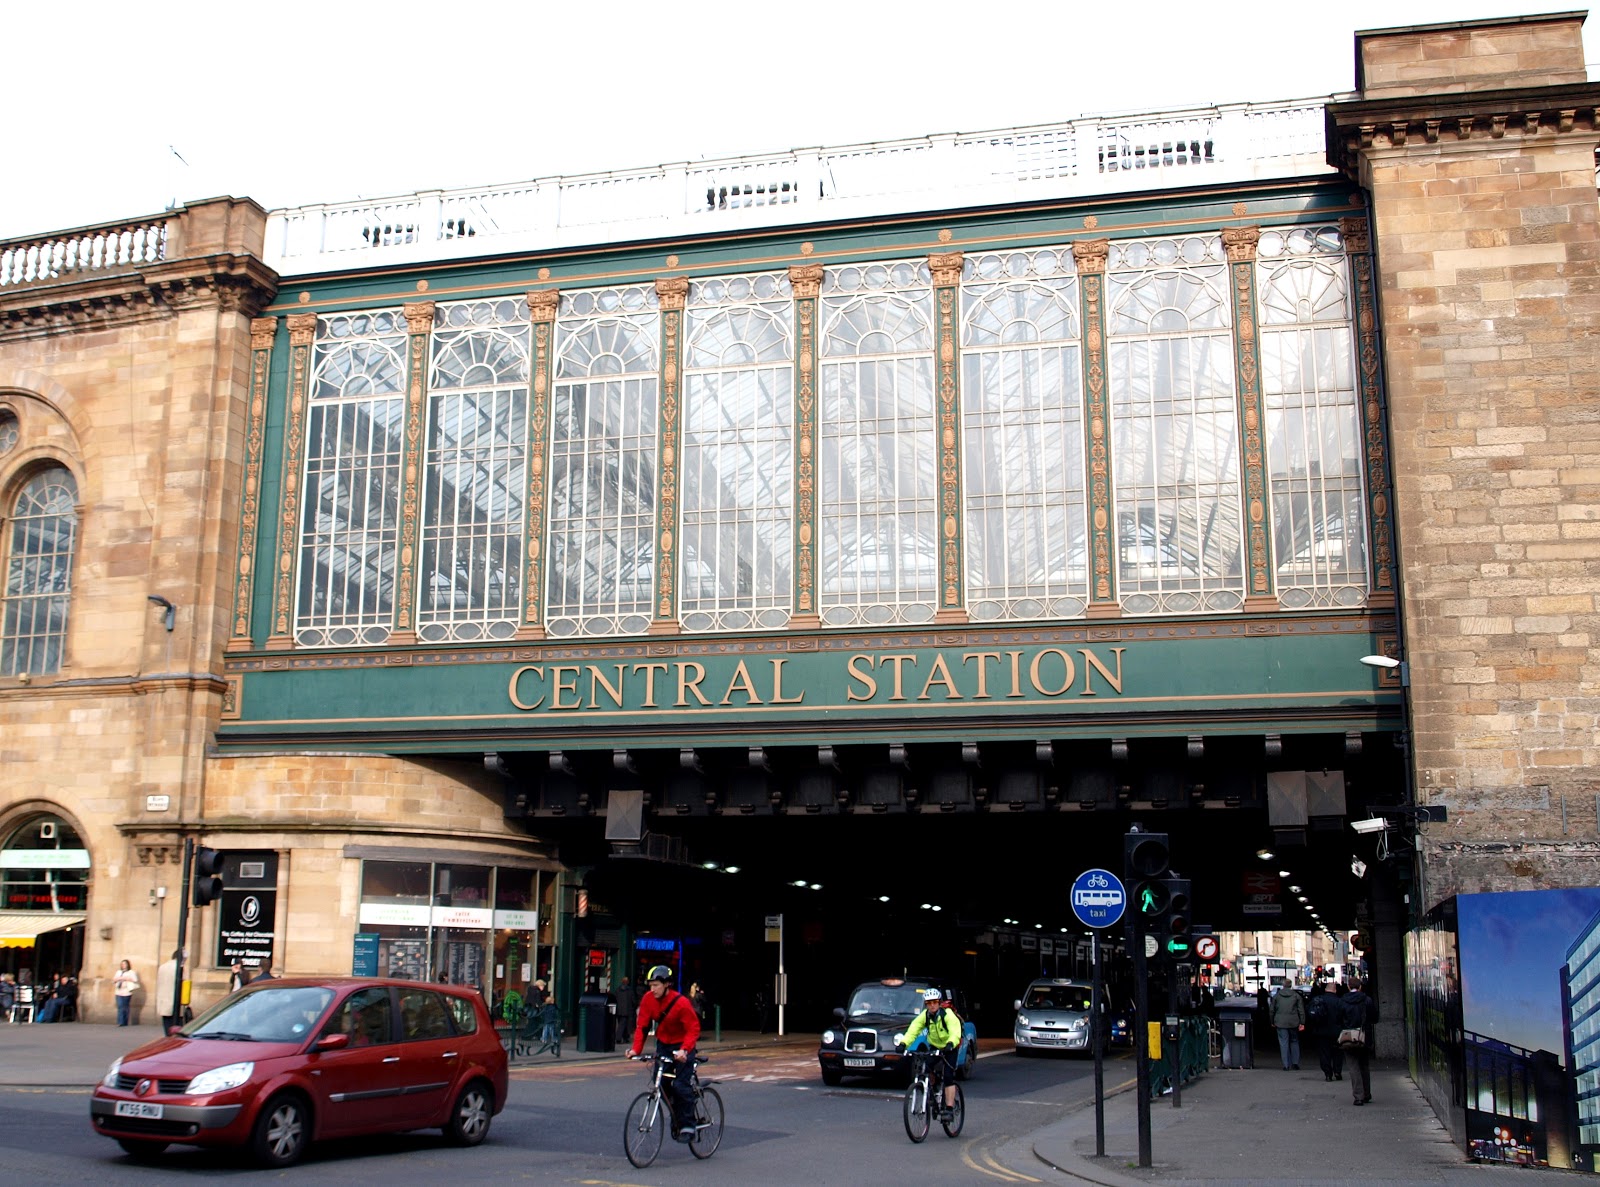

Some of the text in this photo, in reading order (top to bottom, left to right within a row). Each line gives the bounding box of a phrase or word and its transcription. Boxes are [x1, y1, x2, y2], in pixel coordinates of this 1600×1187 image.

[508, 647, 1127, 711] CENTRAL STATION
[1089, 908, 1107, 918] taxi
